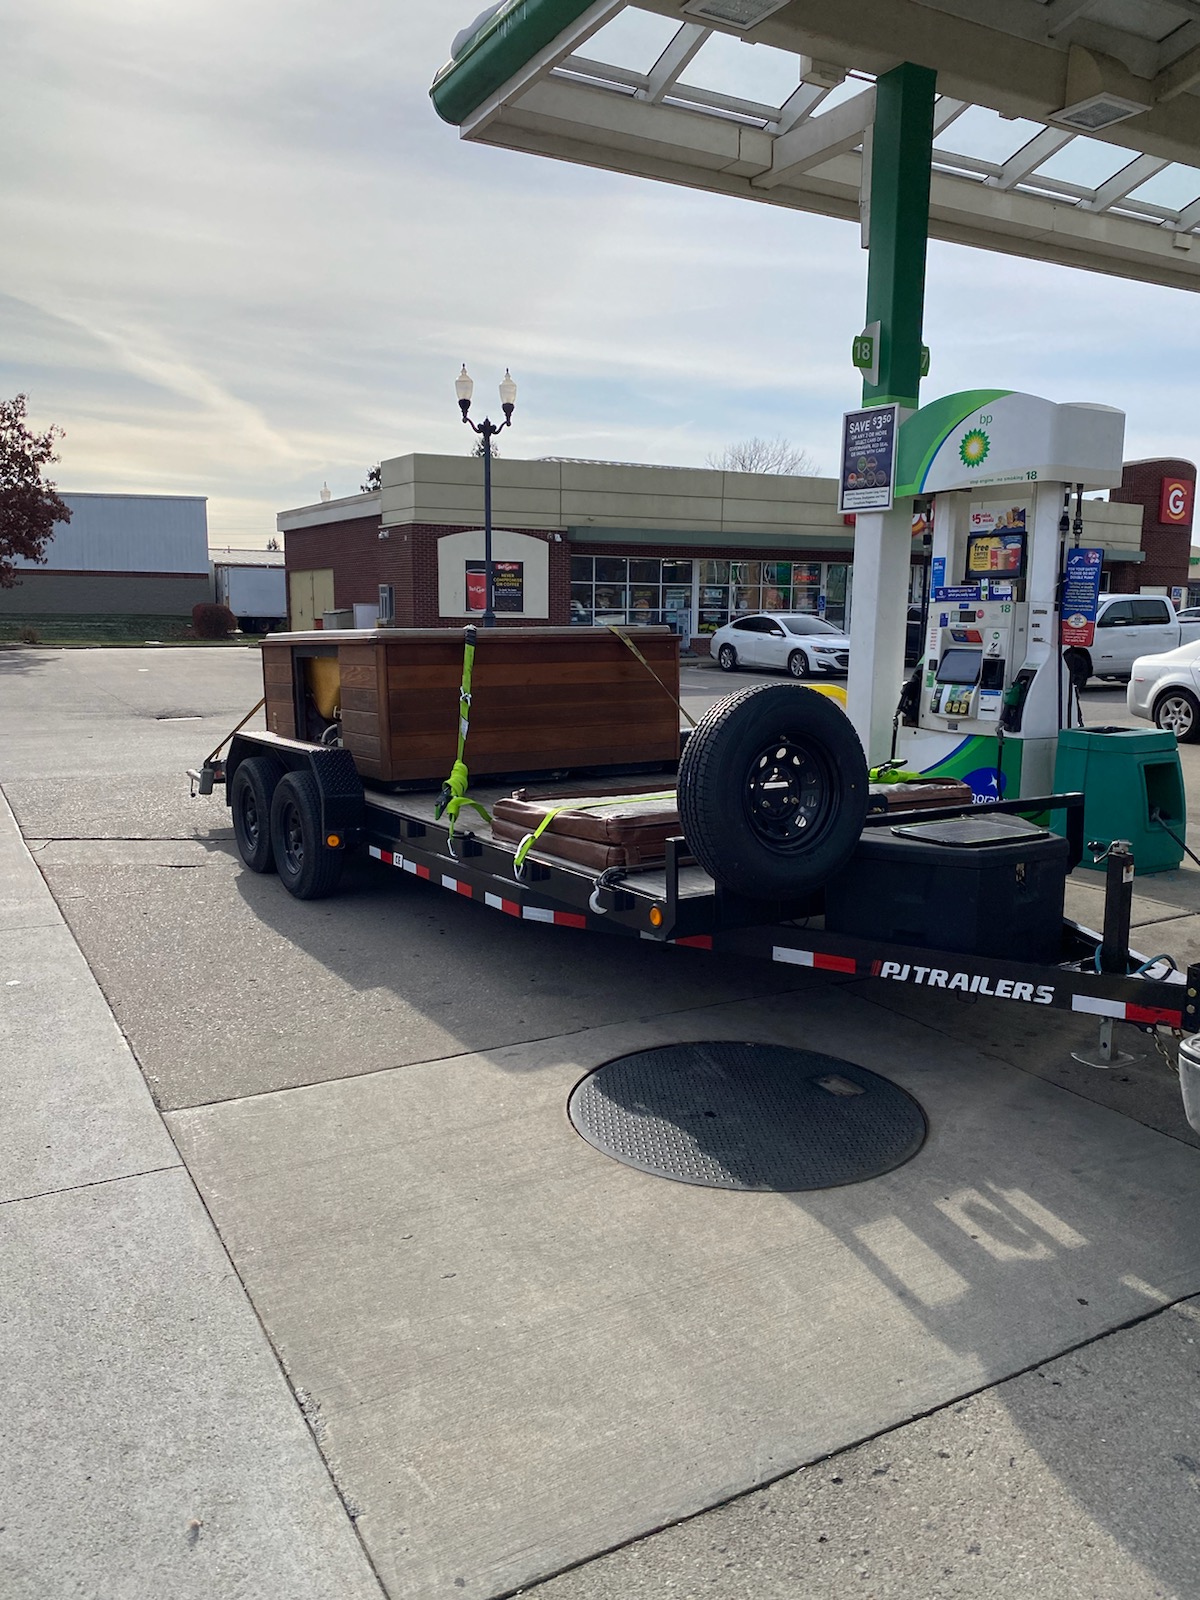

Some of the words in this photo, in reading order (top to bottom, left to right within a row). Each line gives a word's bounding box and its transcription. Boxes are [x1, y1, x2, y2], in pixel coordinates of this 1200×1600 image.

[854, 341, 871, 361] 18
[920, 351, 929, 369] 7
[979, 413, 993, 426] bp
[849, 420, 870, 434] SAVE
[1026, 470, 1038, 480] 18
[1169, 489, 1185, 514] G
[972, 513, 981, 524] $5
[974, 543, 990, 552] free
[1000, 604, 1011, 613] 18
[879, 961, 911, 982] PJ
[913, 965, 1056, 1005] TRAILERS
